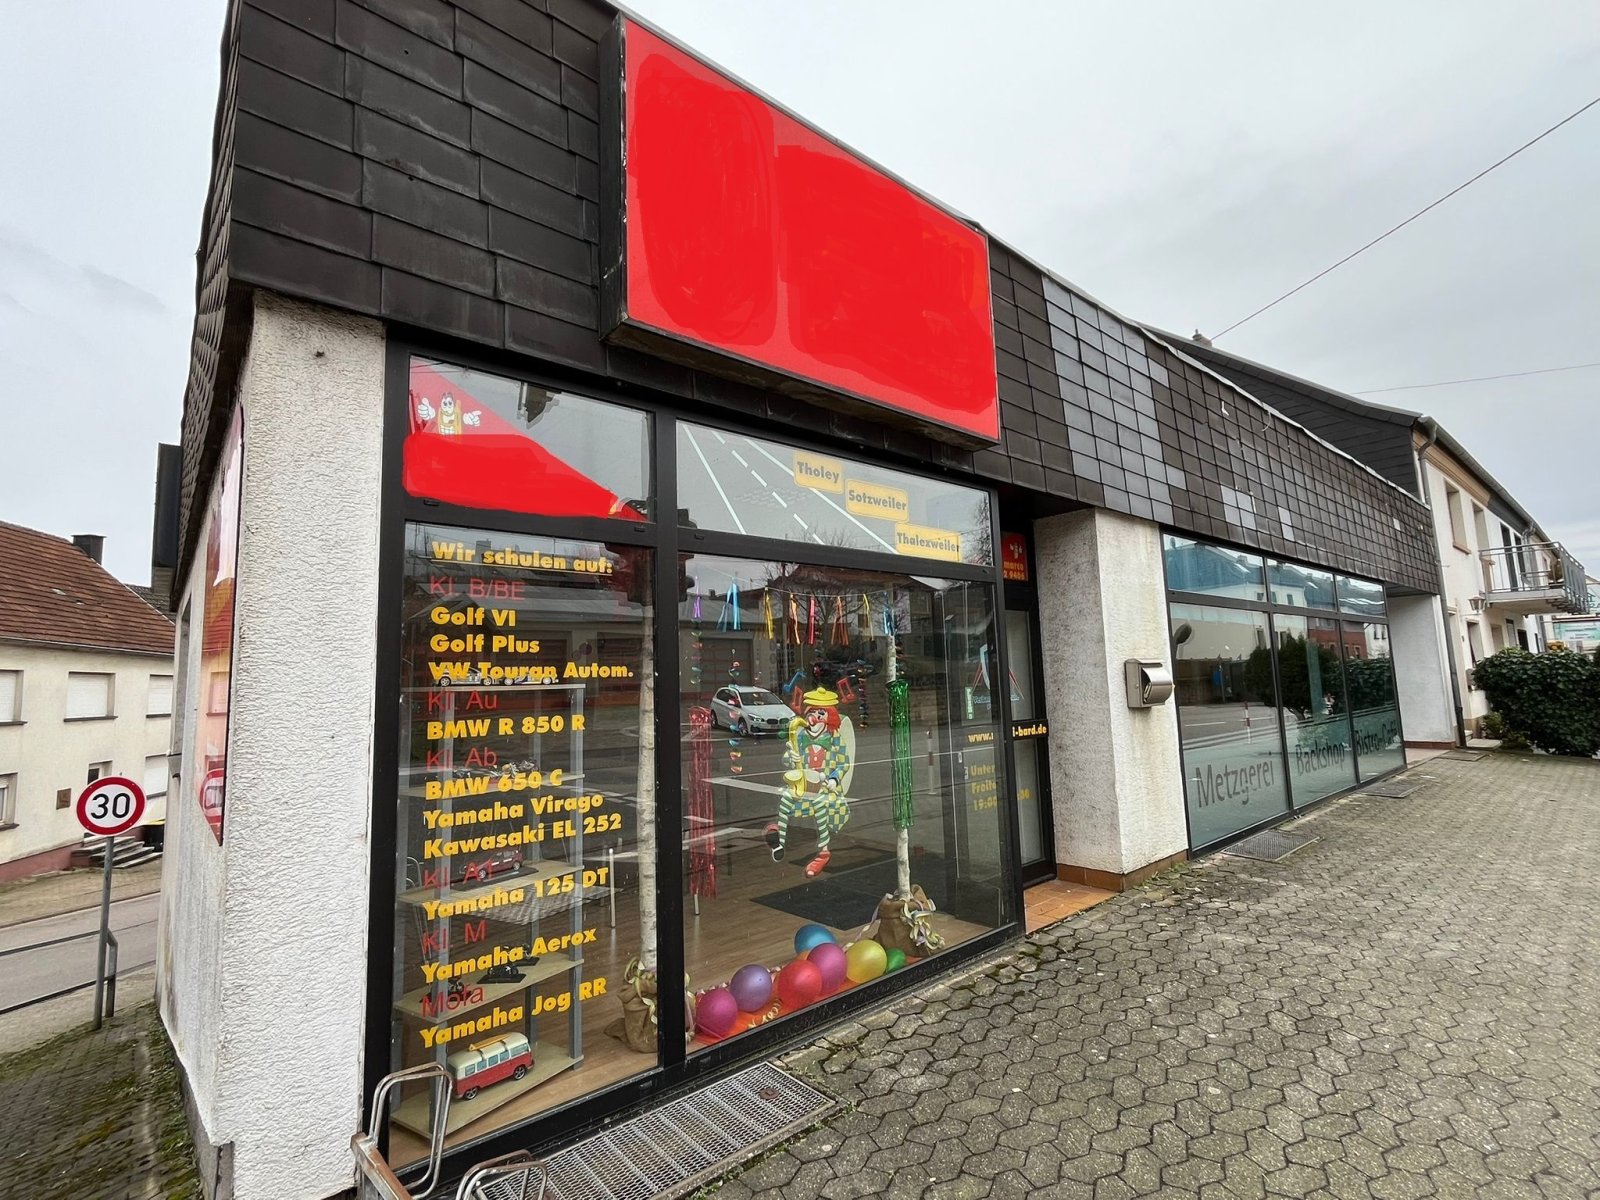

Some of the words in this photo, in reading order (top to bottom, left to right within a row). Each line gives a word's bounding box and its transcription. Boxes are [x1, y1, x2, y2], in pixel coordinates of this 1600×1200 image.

[797, 460, 840, 484] Tholey
[848, 489, 907, 511] Sotzweiler
[897, 532, 960, 552] Thalexweiler
[432, 541, 475, 562] Wir
[482, 550, 566, 570] schulen
[573, 559, 613, 574] auf:
[469, 577, 527, 601] B/BE
[430, 606, 485, 626] Golf
[491, 609, 517, 627] VI
[429, 633, 485, 653] Golf
[492, 634, 541, 654] Plus
[428, 662, 471, 681] VW
[477, 662, 558, 680] Touran
[563, 662, 634, 678] Autom.
[466, 690, 498, 711] Au
[427, 719, 491, 740] BMW
[498, 718, 514, 736] R
[521, 715, 565, 734] 850
[571, 714, 586, 732] R
[465, 747, 498, 768] Ab
[1296, 738, 1346, 777] Backshop
[425, 776, 490, 800] BMW
[497, 771, 542, 792] 650
[549, 769, 563, 786] C
[1196, 760, 1275, 808] Metzgerei
[91, 793, 131, 819] 30
[425, 802, 524, 829] Yamaha
[530, 794, 604, 815] Virago
[424, 827, 544, 859] Kawasaki
[552, 819, 577, 839] EL
[583, 814, 622, 834] 252
[422, 887, 524, 921] Yamaha
[534, 876, 575, 897] 125
[582, 867, 609, 887] DT
[464, 920, 487, 944] M
[420, 944, 524, 984] Yamaha
[531, 927, 598, 956] Aerox
[419, 1004, 523, 1049] Yamaha
[531, 991, 571, 1016] Jog
[578, 977, 607, 1000] RR
[421, 985, 484, 1018] Mofa
